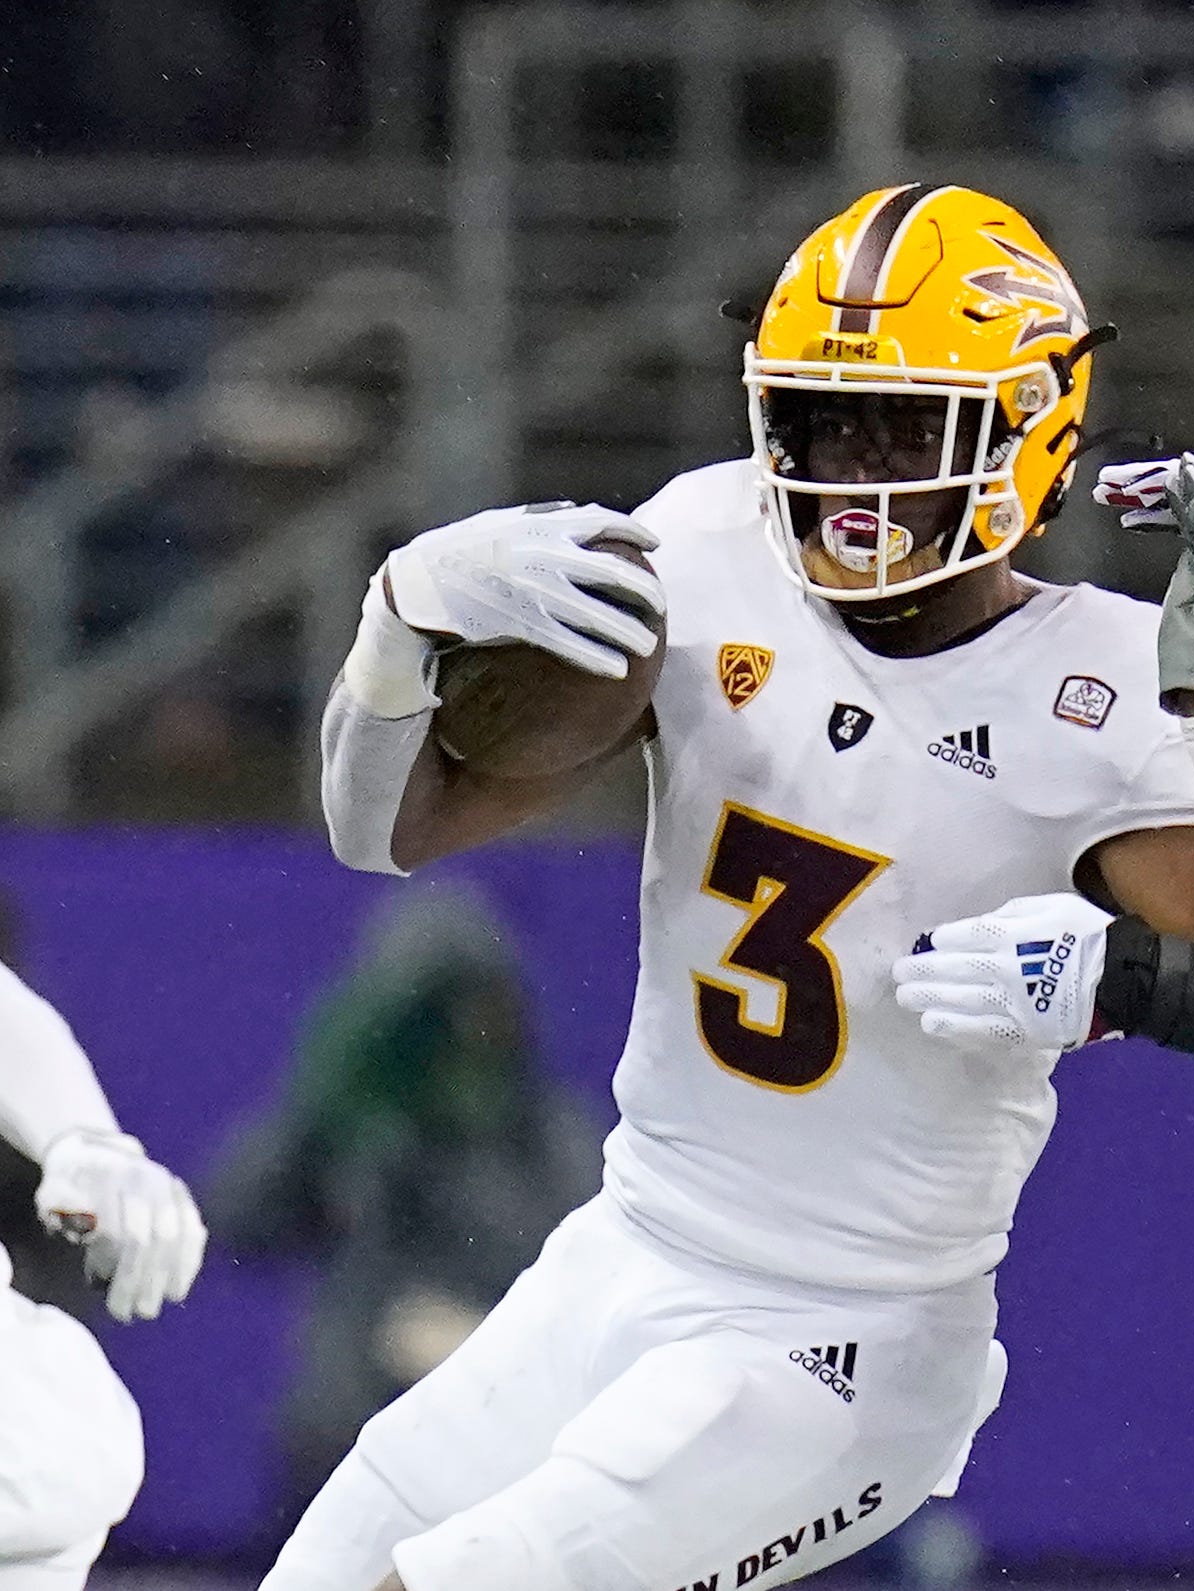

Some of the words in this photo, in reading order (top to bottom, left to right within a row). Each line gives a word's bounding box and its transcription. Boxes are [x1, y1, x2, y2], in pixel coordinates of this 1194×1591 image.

[722, 647, 771, 685] PAC
[728, 671, 753, 696] 12
[927, 742, 997, 779] adidas
[690, 800, 894, 1094] 3
[1035, 932, 1075, 1012] adidas
[789, 1350, 856, 1403] adidas
[737, 1482, 882, 1588] DEVILS
